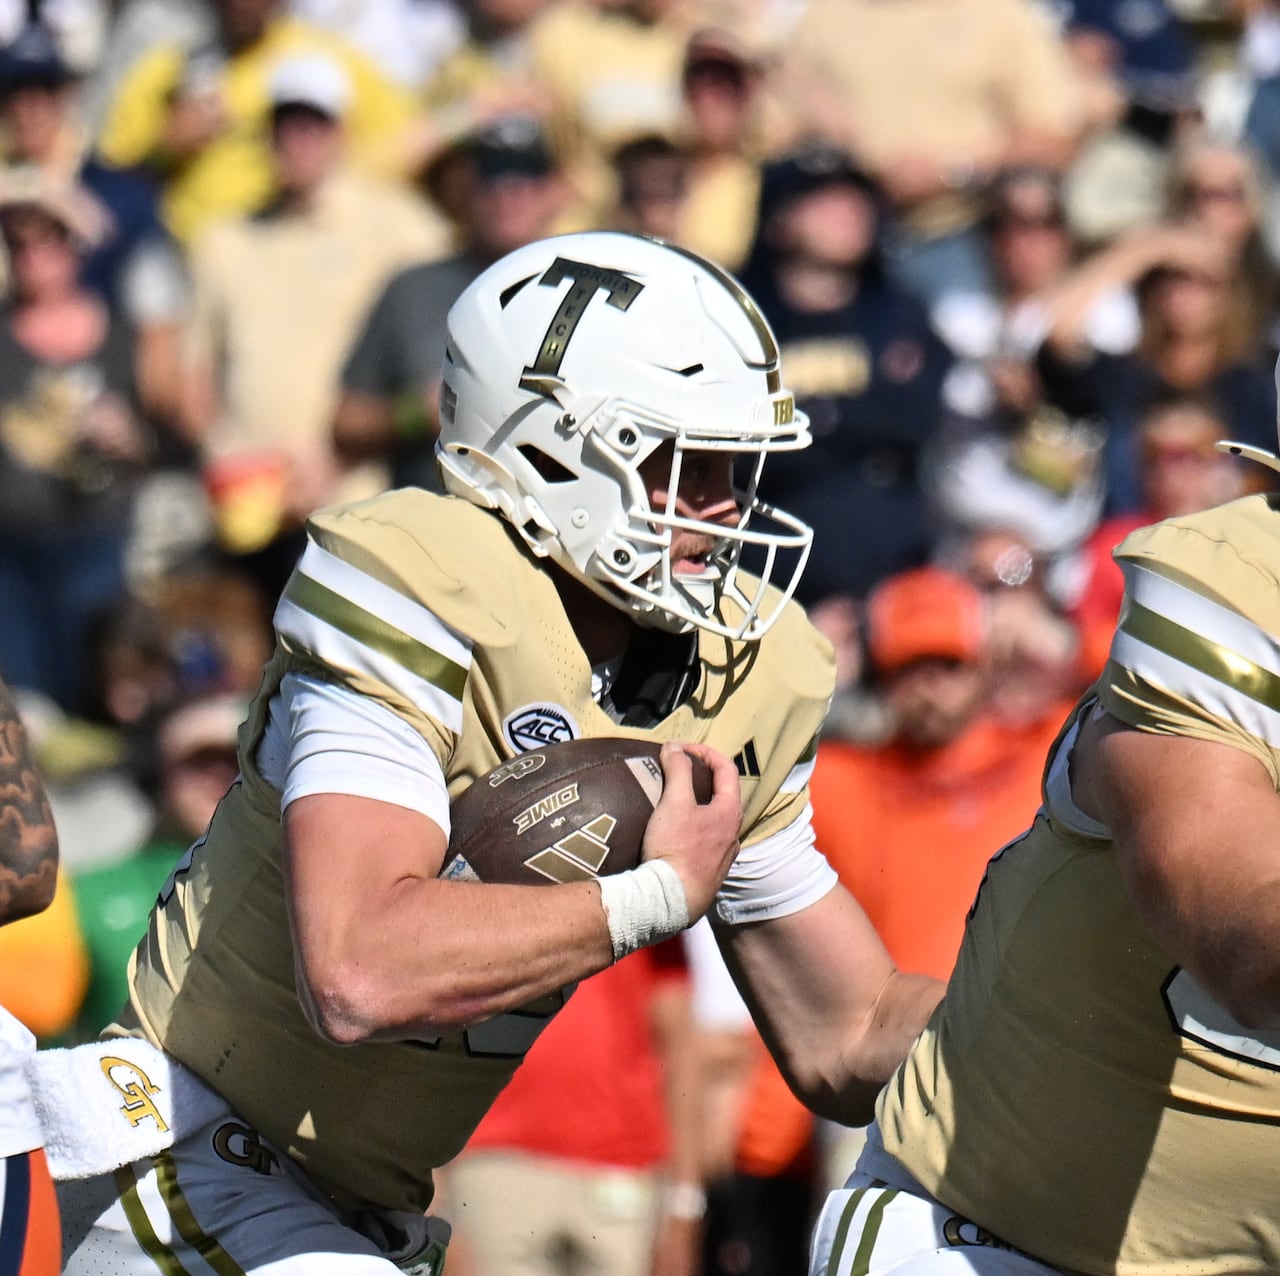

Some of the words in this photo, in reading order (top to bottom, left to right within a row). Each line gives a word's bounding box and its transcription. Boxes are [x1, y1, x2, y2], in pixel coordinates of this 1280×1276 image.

[546, 287, 588, 358] TECH
[523, 718, 568, 745] ACC
[512, 782, 581, 836] DIME
[99, 1056, 170, 1133] GT
